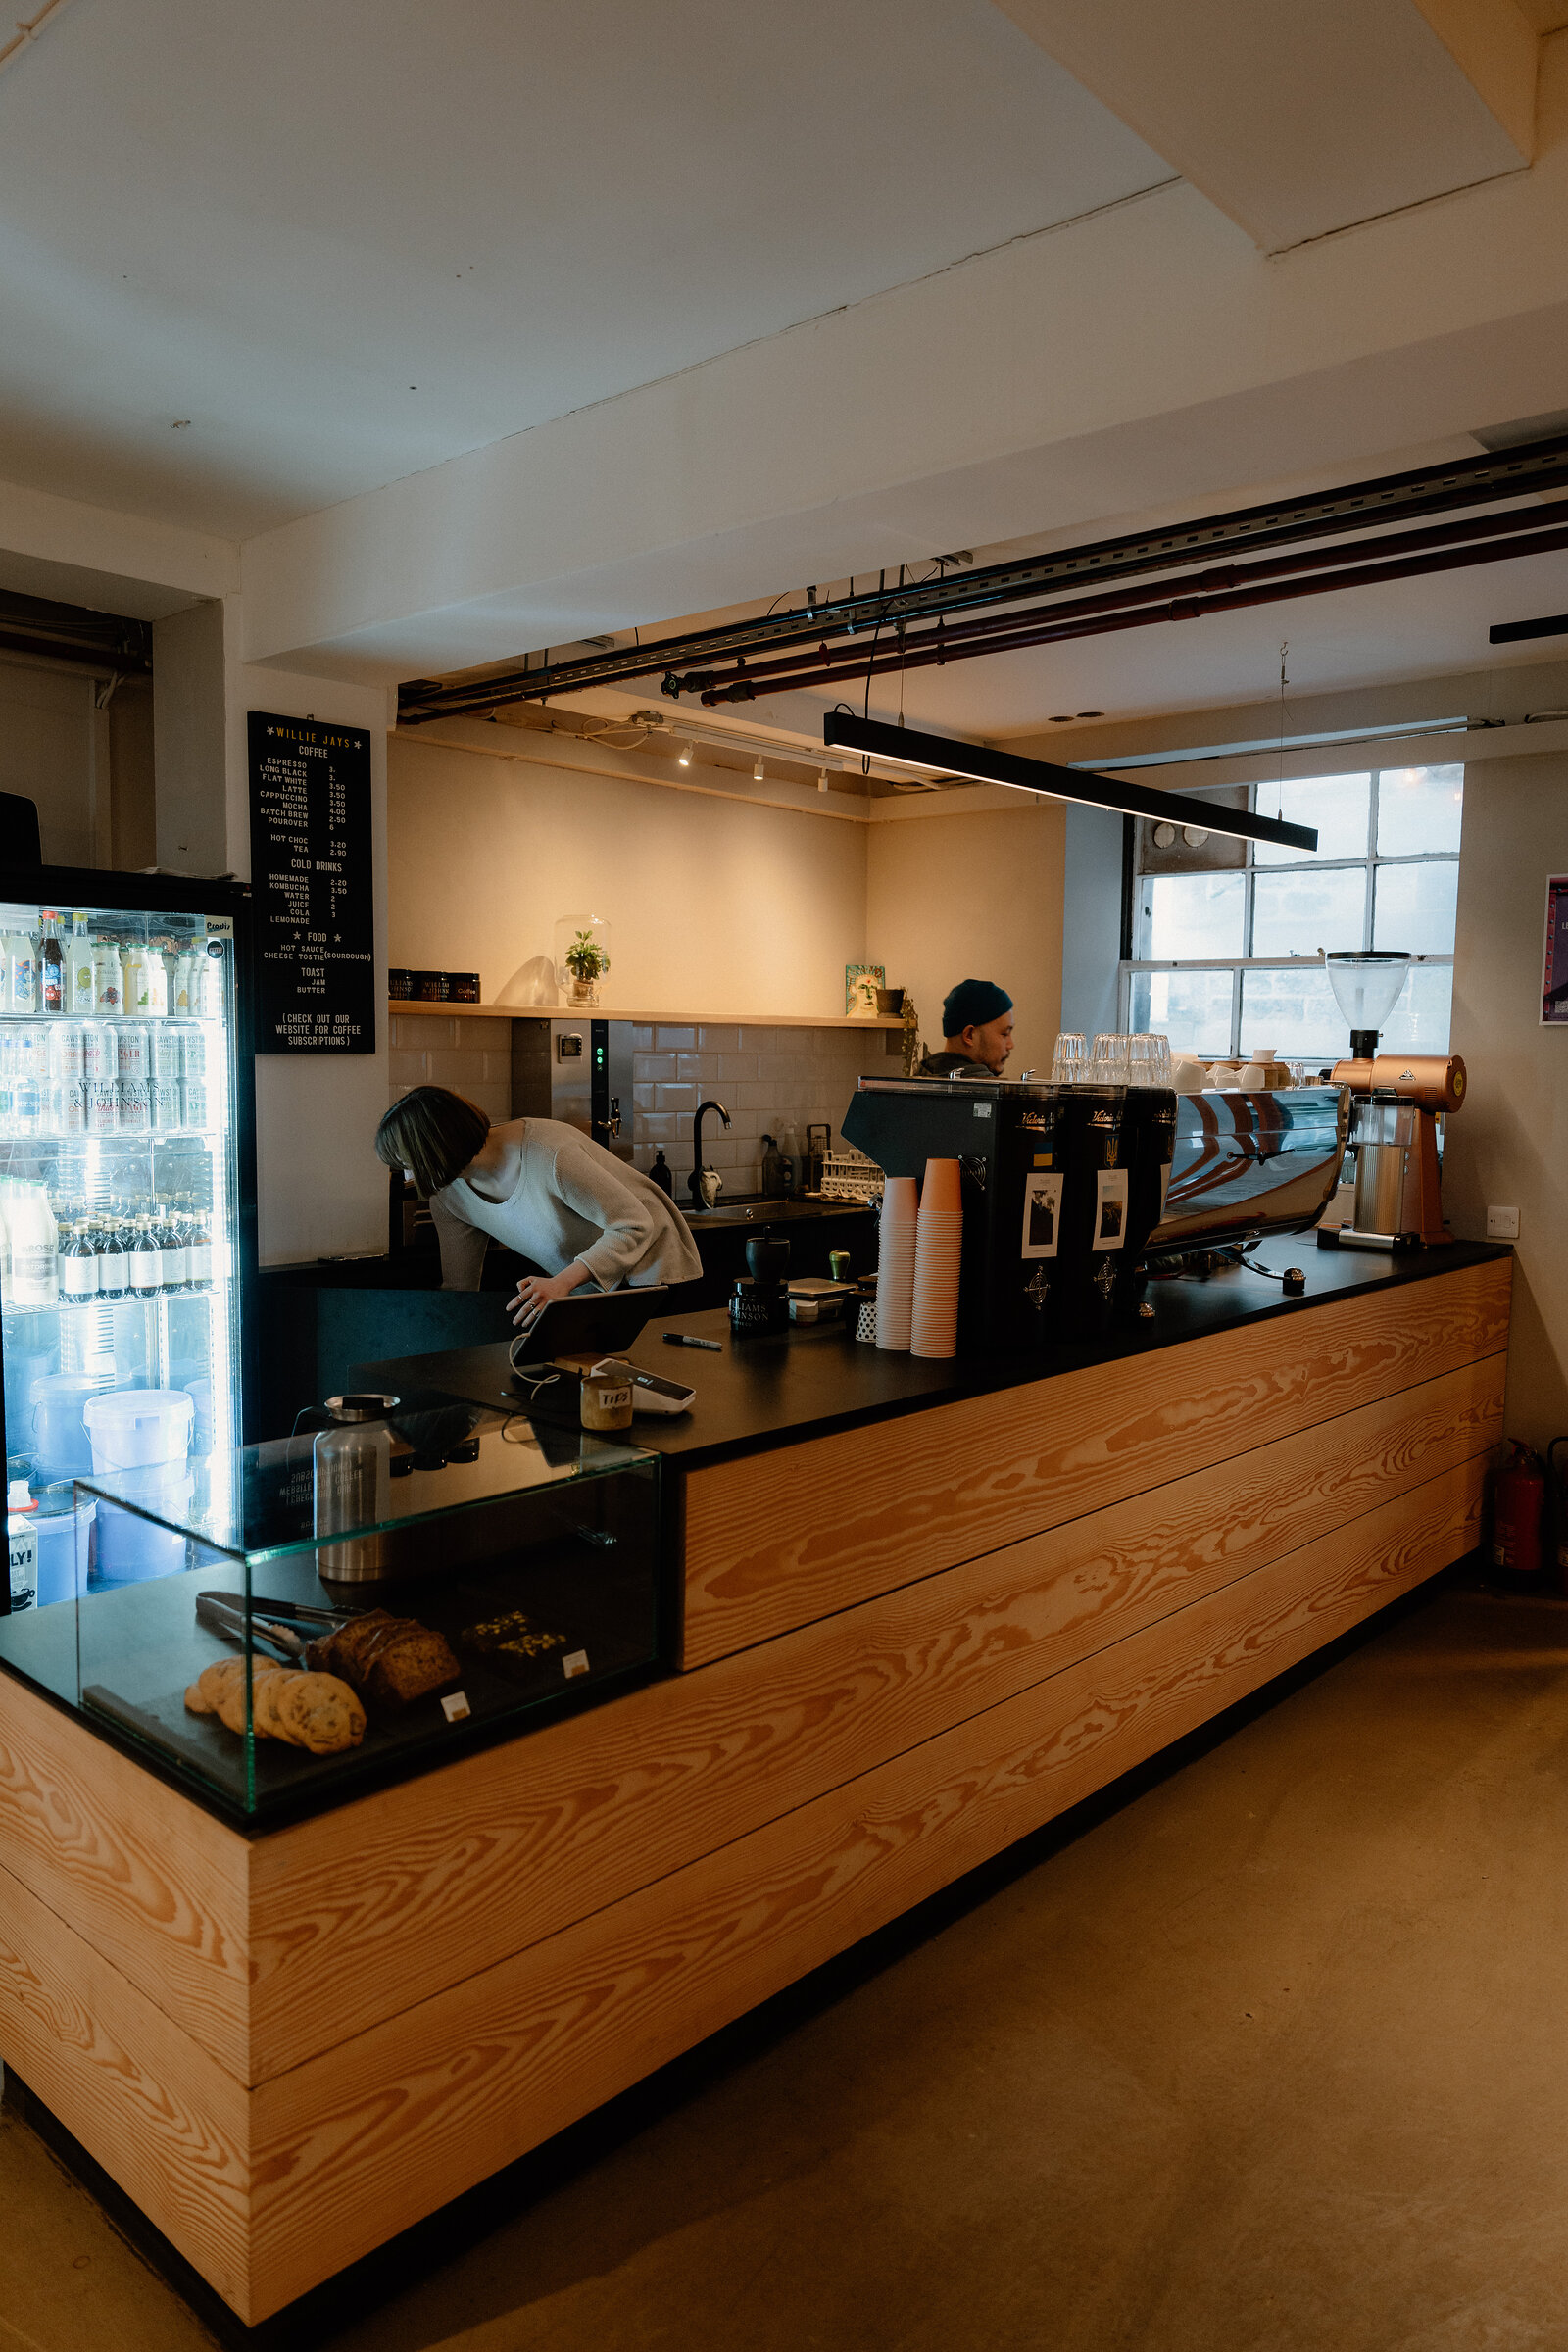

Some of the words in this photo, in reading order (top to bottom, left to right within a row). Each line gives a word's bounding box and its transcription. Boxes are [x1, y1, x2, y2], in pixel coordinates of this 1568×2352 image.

[276, 726, 317, 743] WILLIE
[323, 735, 350, 748] JAYS
[298, 745, 328, 759] COFFEE
[267, 757, 307, 769] ESPRESSO
[259, 764, 280, 773] LONG
[282, 767, 308, 777] BLACK
[262, 773, 282, 782] FLAT
[284, 776, 308, 786] WHITE
[282, 785, 308, 795] LATTE
[259, 790, 308, 803] CAPPUCCINO
[282, 802, 308, 811] MOCHA
[329, 808, 346, 816] 4.00
[260, 807, 286, 816] BATCH
[288, 810, 309, 819] BREW
[268, 816, 309, 828] POUROVER
[270, 833, 286, 843] HOT
[329, 840, 347, 849] 3.20
[290, 858, 312, 869] COLD
[316, 860, 343, 872] DRINKS
[269, 873, 309, 884] HOMEMADE
[270, 882, 310, 892] KOMBUCHA
[283, 891, 310, 900] WATER
[287, 900, 310, 908] JUICE
[270, 915, 310, 925] LEMONADE
[307, 931, 327, 942] FOOD
[264, 952, 294, 960] CHEESE
[298, 953, 324, 961] TOSTIE
[324, 951, 371, 962] (SOURDOUGH)
[301, 967, 325, 977] TOAST
[282, 1013, 313, 1024] (CHECK
[316, 1013, 331, 1024] OUT
[335, 1014, 350, 1024] OUR
[275, 1024, 310, 1035] WEBSITE
[314, 1025, 329, 1035] FOR
[332, 1025, 362, 1035] COFFEE
[287, 1035, 351, 1046] SUBSCRIPTIONS)
[78, 1082, 159, 1093] WILLIAMS
[74, 1098, 83, 1107] &
[87, 1097, 164, 1109] JOHNSON
